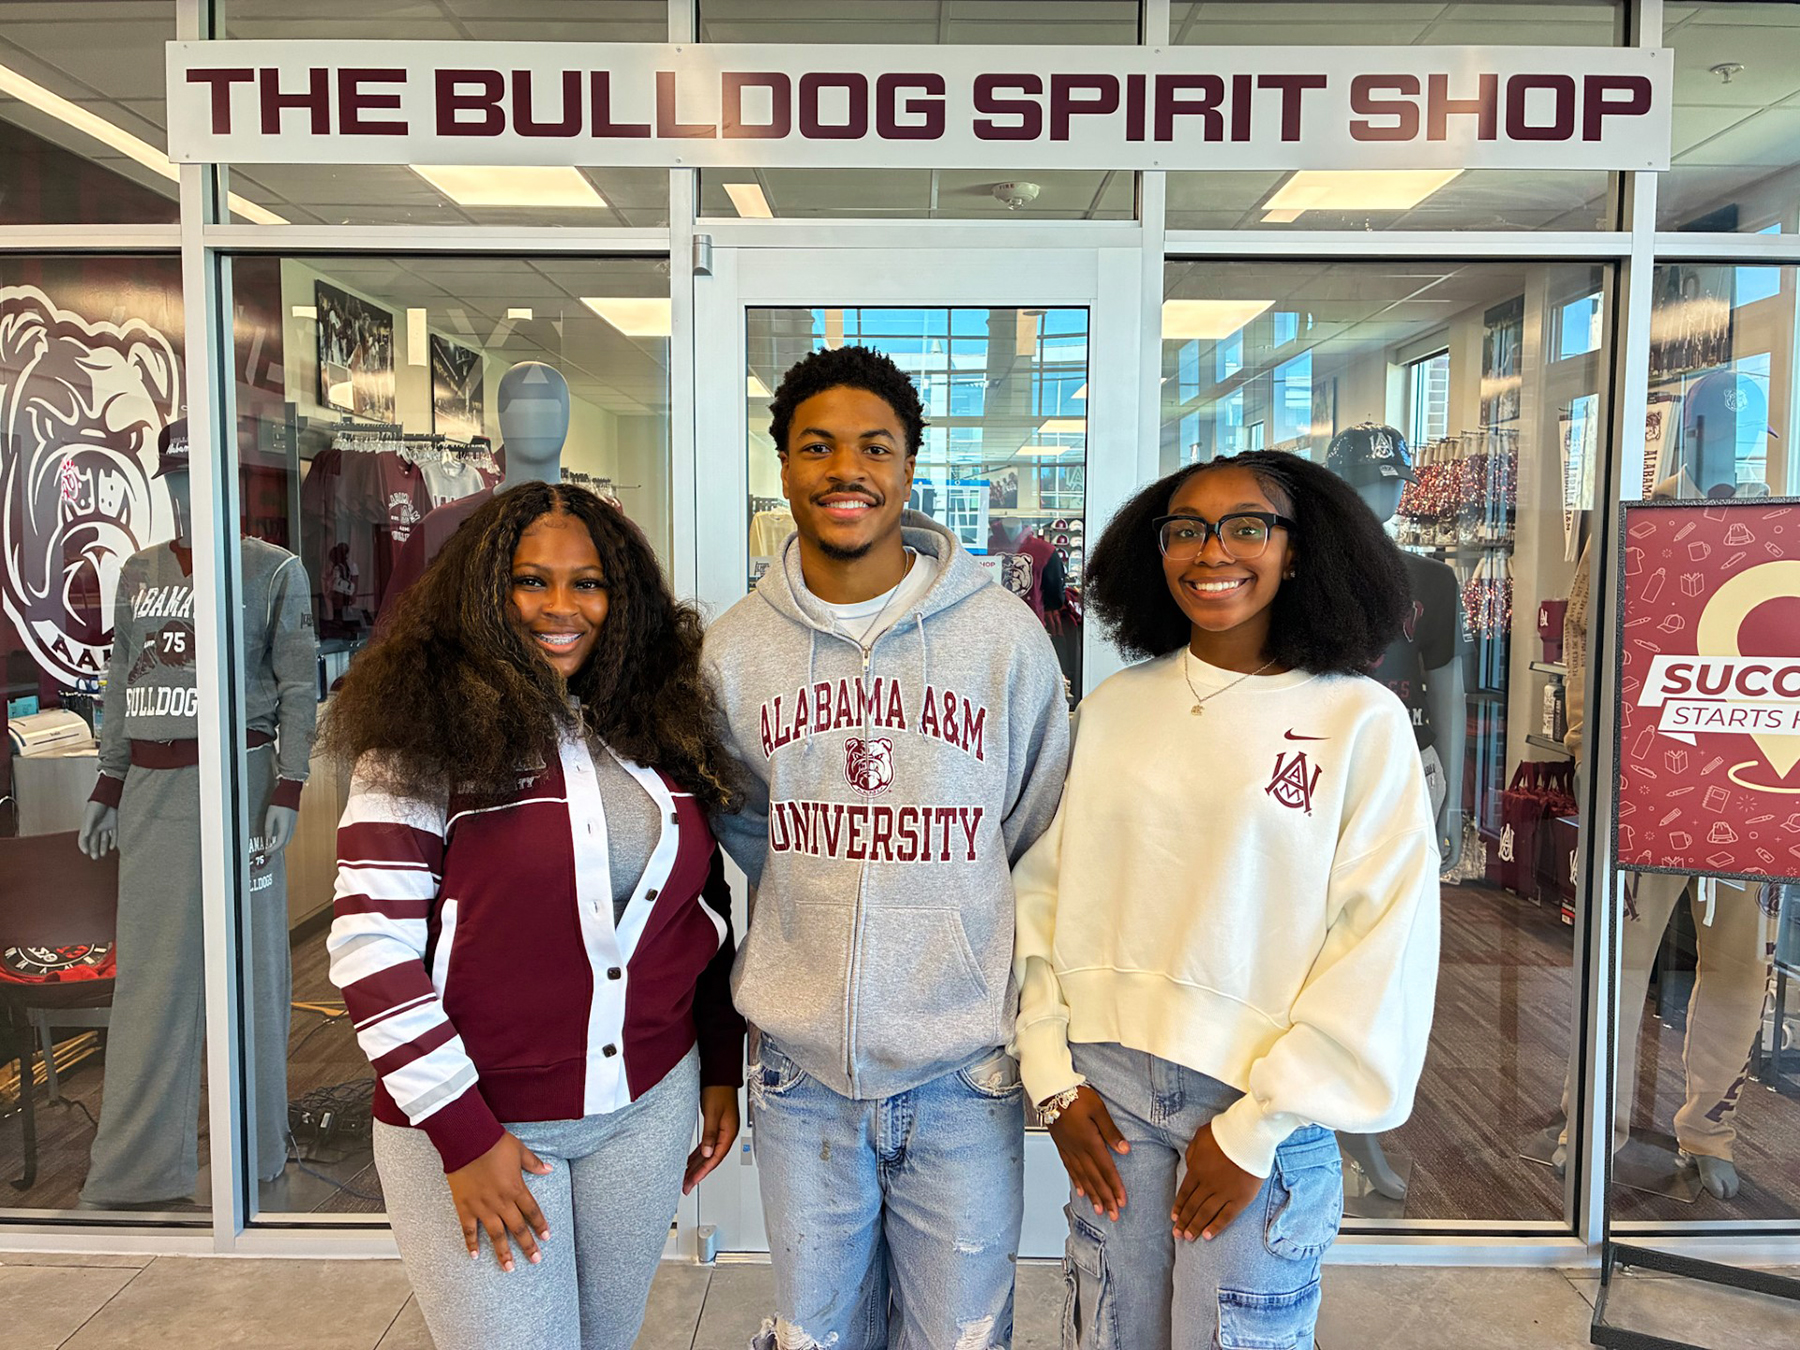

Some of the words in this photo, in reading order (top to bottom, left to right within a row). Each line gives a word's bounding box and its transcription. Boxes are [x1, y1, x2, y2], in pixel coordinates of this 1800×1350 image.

[186, 69, 409, 135] THE
[434, 70, 946, 139] BULLDOG
[972, 73, 1328, 142] SPIRIT
[1350, 73, 1652, 142] SHOP
[162, 631, 186, 653] 75
[761, 676, 907, 760] ALABAMA
[920, 684, 987, 764] A&M
[1672, 706, 1784, 729] STARTS
[770, 800, 984, 862] UNIVERSITY
